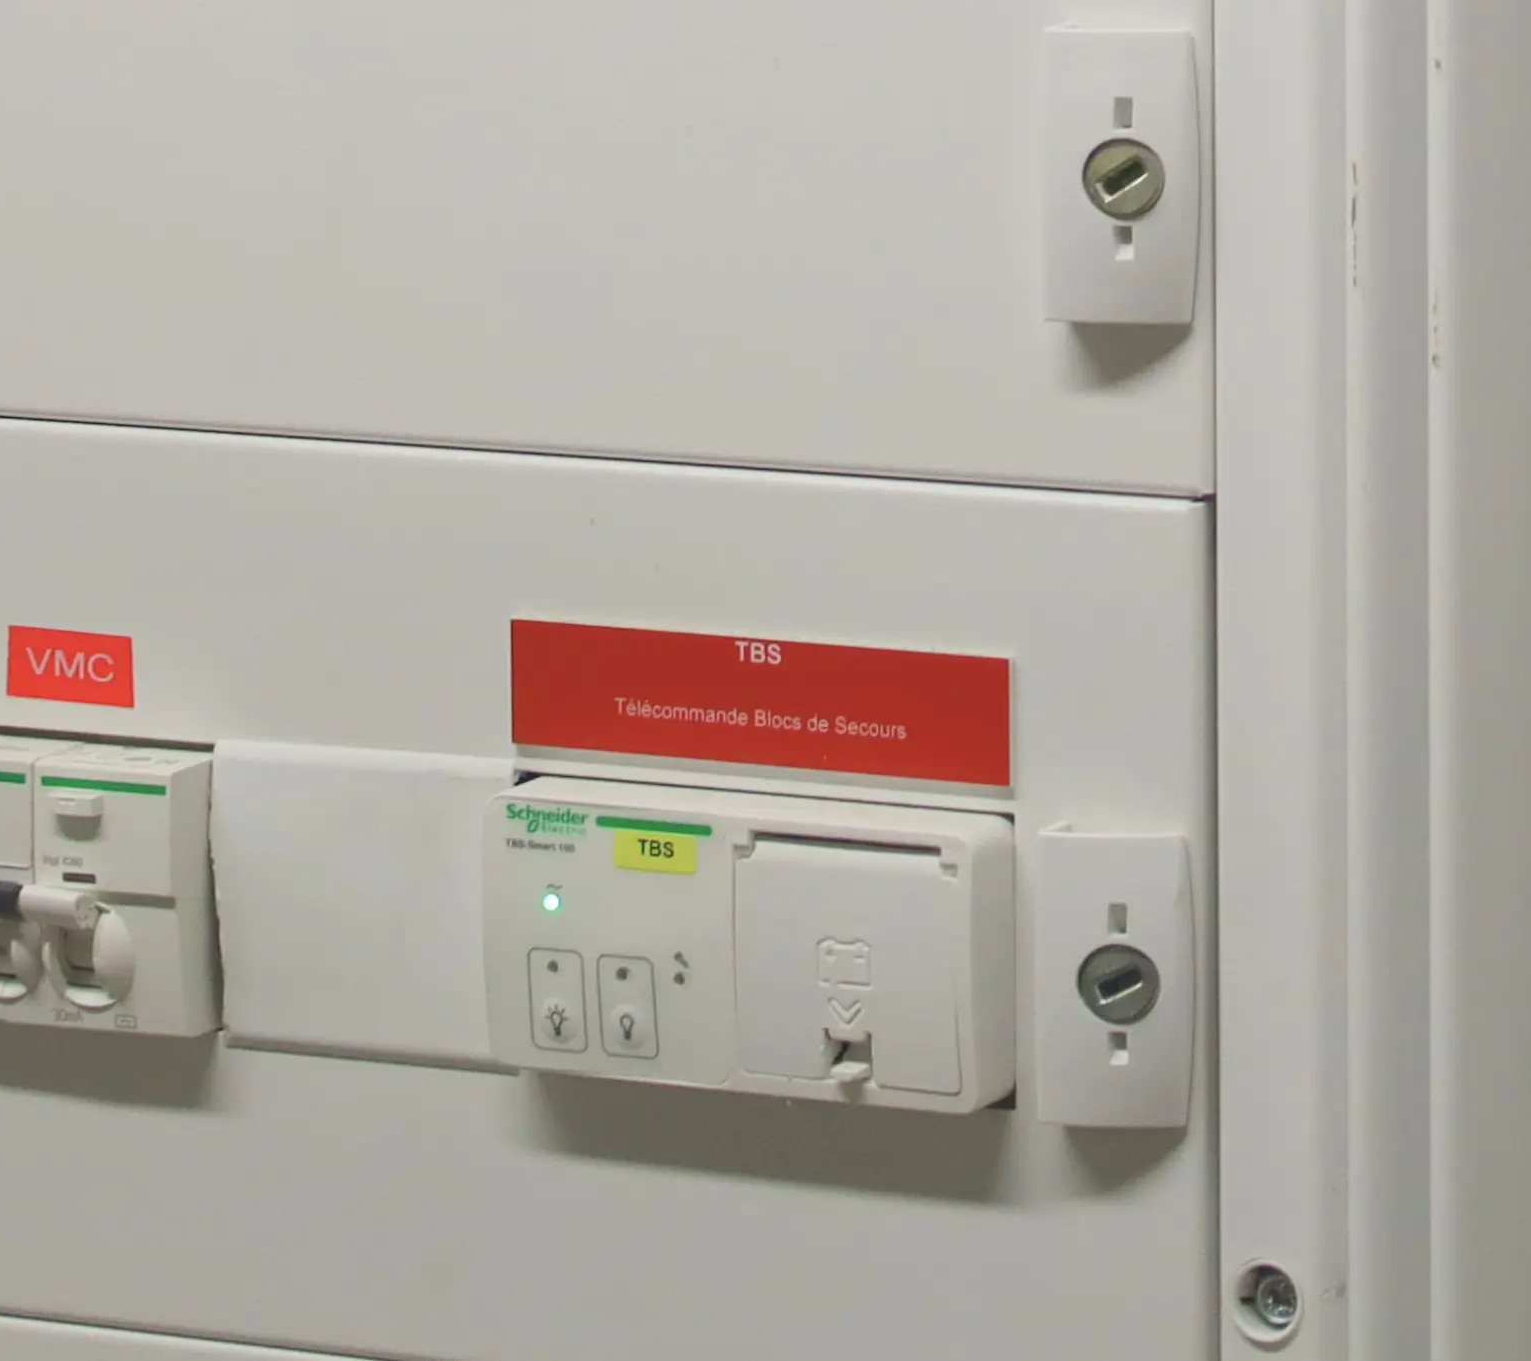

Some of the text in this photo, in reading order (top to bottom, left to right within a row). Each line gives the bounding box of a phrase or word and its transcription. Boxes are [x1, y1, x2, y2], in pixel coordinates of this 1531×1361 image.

[25, 646, 115, 683] VMC
[735, 637, 785, 665] TBS
[614, 697, 907, 740] Télécommande Blocs de Secours
[505, 803, 589, 833] Schneider
[636, 837, 676, 859] TBS
